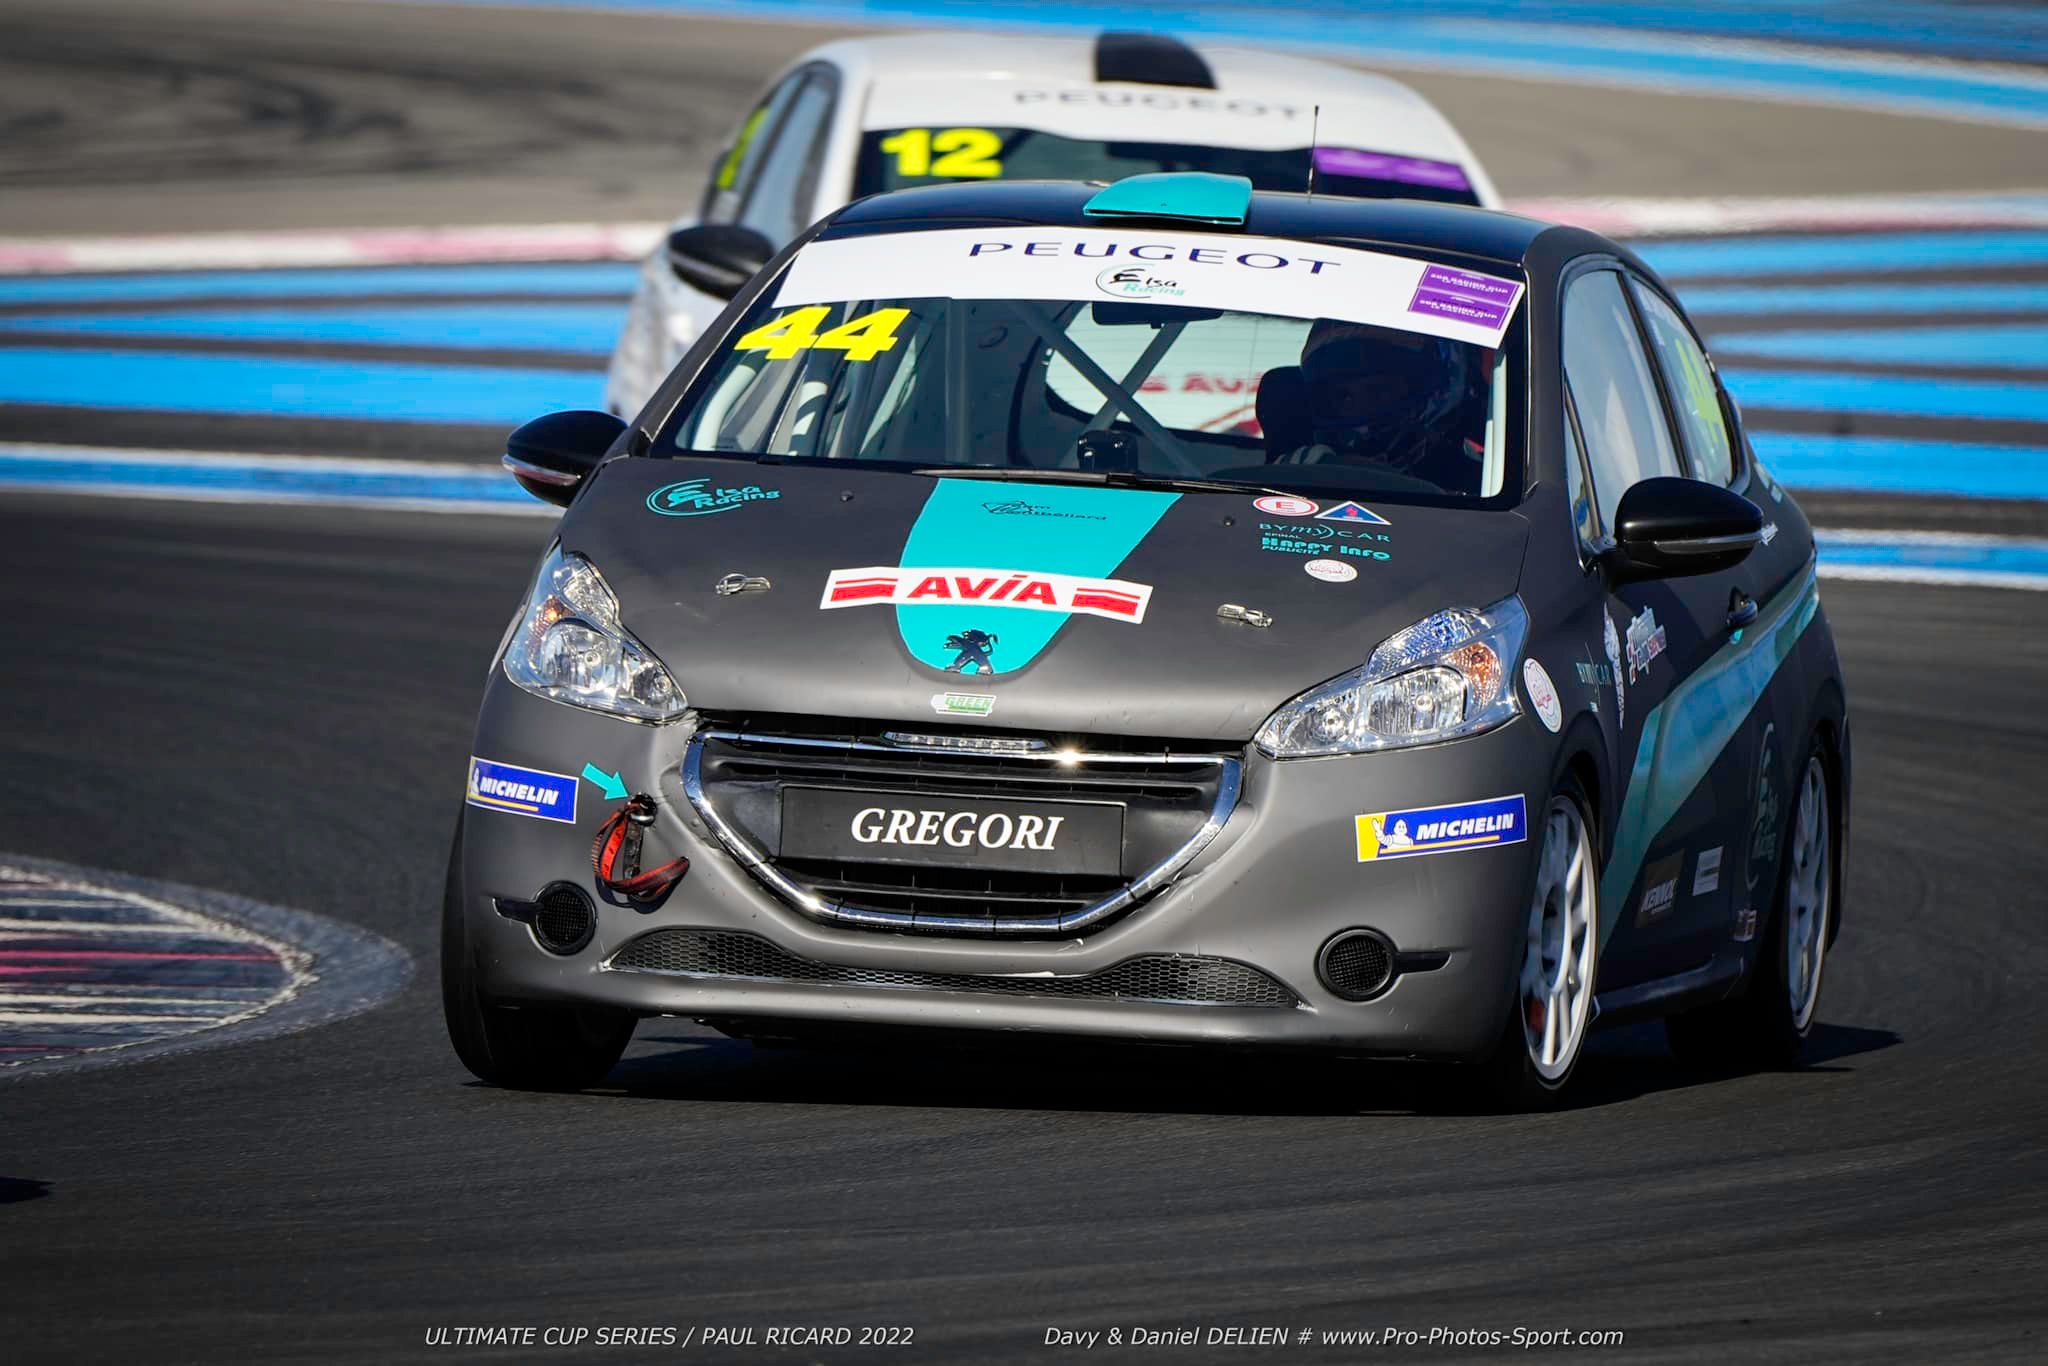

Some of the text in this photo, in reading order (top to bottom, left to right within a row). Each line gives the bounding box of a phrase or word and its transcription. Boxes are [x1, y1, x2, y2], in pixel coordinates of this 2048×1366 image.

[1015, 92, 1301, 120] PEUGEOT
[881, 128, 1003, 178] 12
[968, 241, 1342, 275] PEUGEOT
[734, 306, 912, 361] 44
[694, 490, 780, 509] Racing
[480, 777, 559, 806] MICHELIN
[851, 807, 1064, 850] GREGORI
[1416, 813, 1515, 841] MICHELIN
